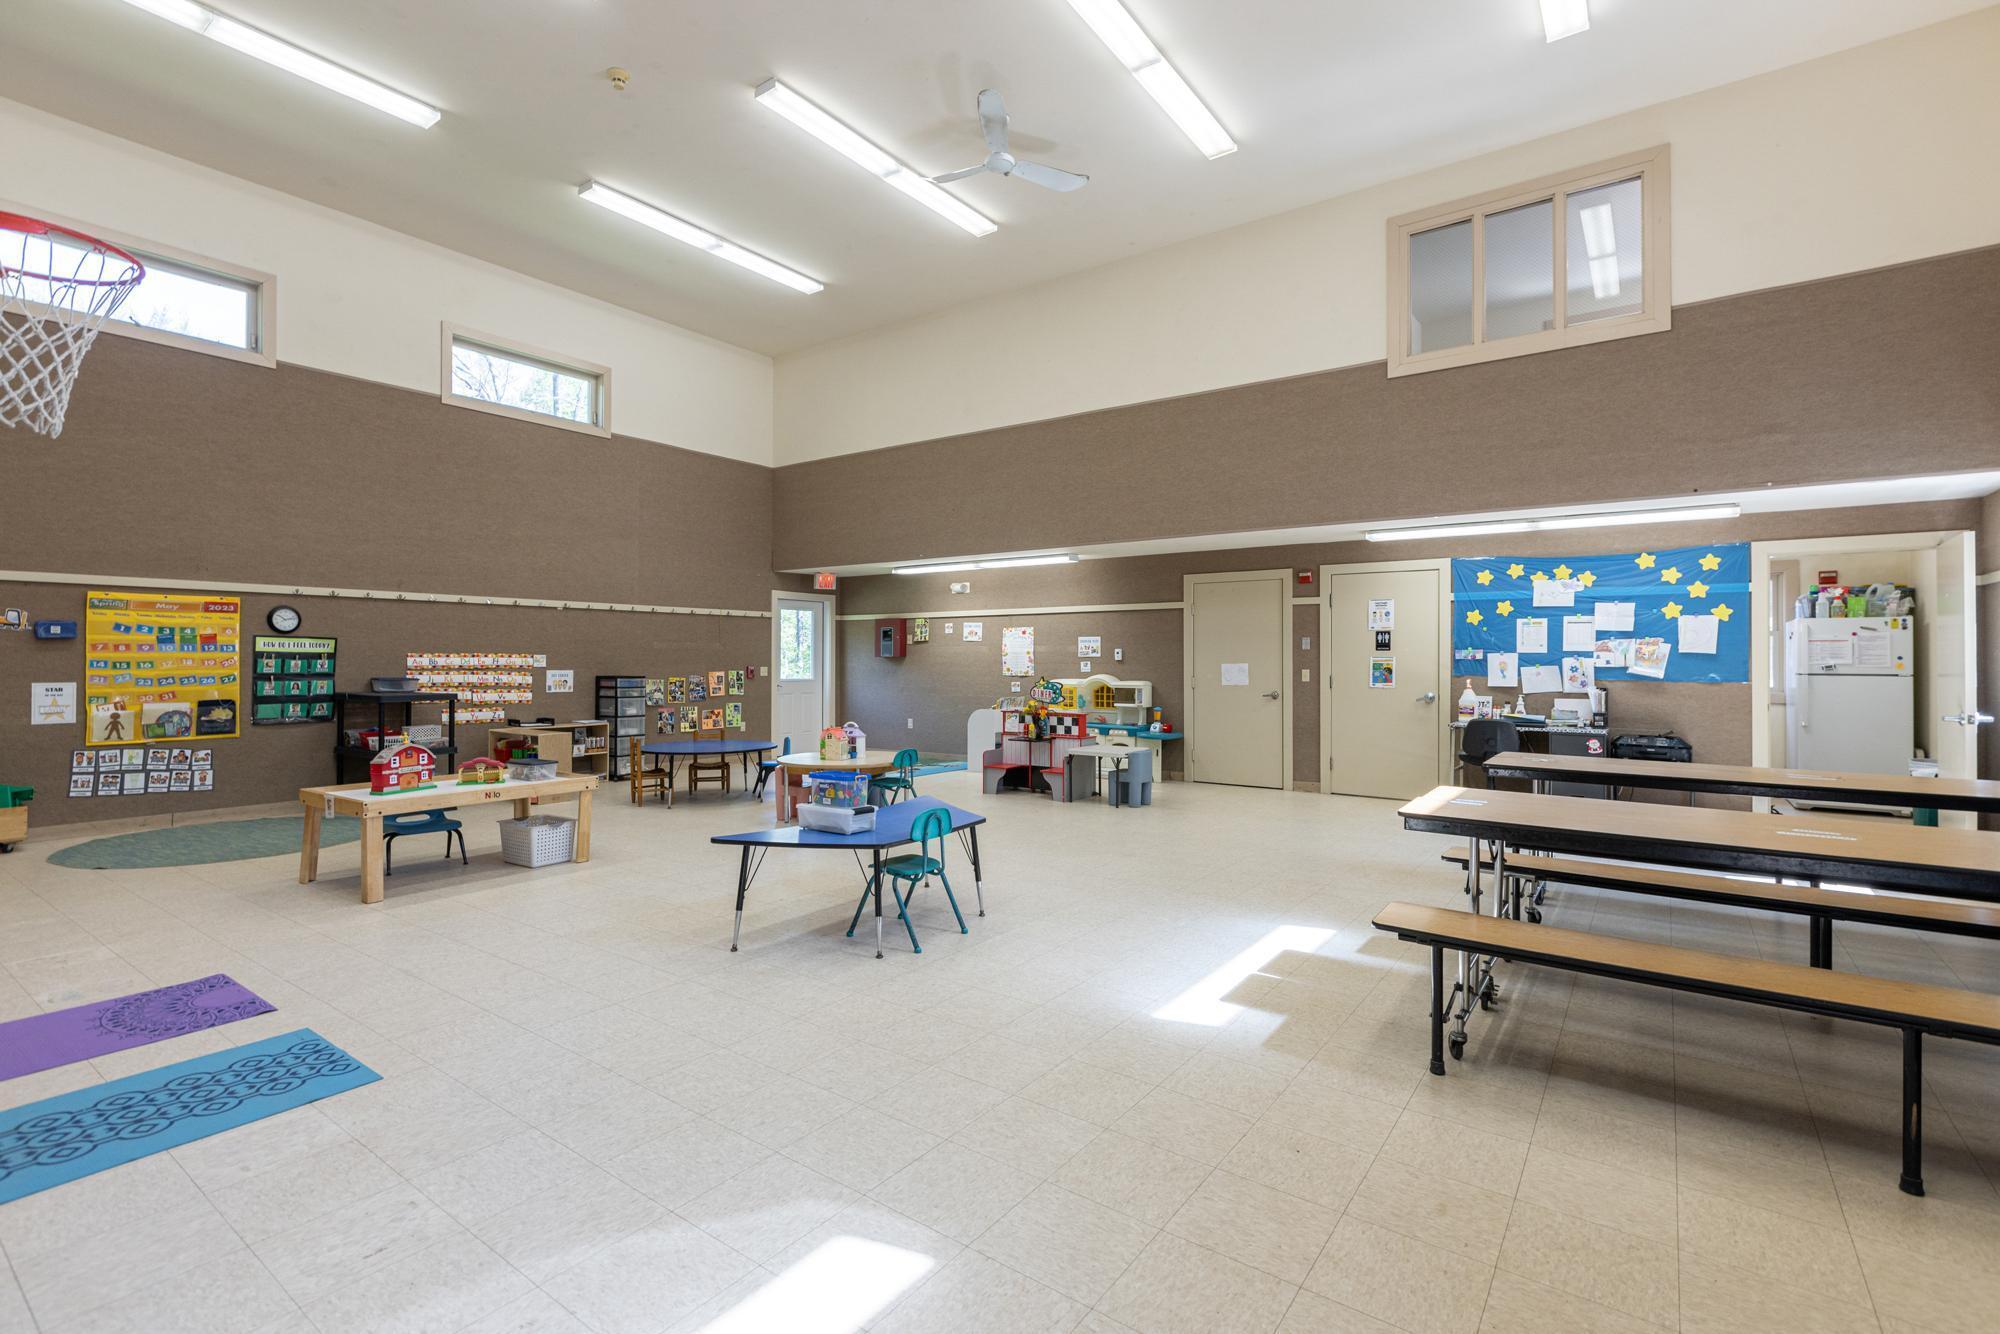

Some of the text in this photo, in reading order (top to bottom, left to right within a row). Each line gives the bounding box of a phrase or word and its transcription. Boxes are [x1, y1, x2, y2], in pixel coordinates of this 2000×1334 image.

[91, 599, 124, 608] Spring
[222, 659, 235, 667] 20
[1032, 689, 1052, 698] DINER
[471, 712, 478, 720] Yy
